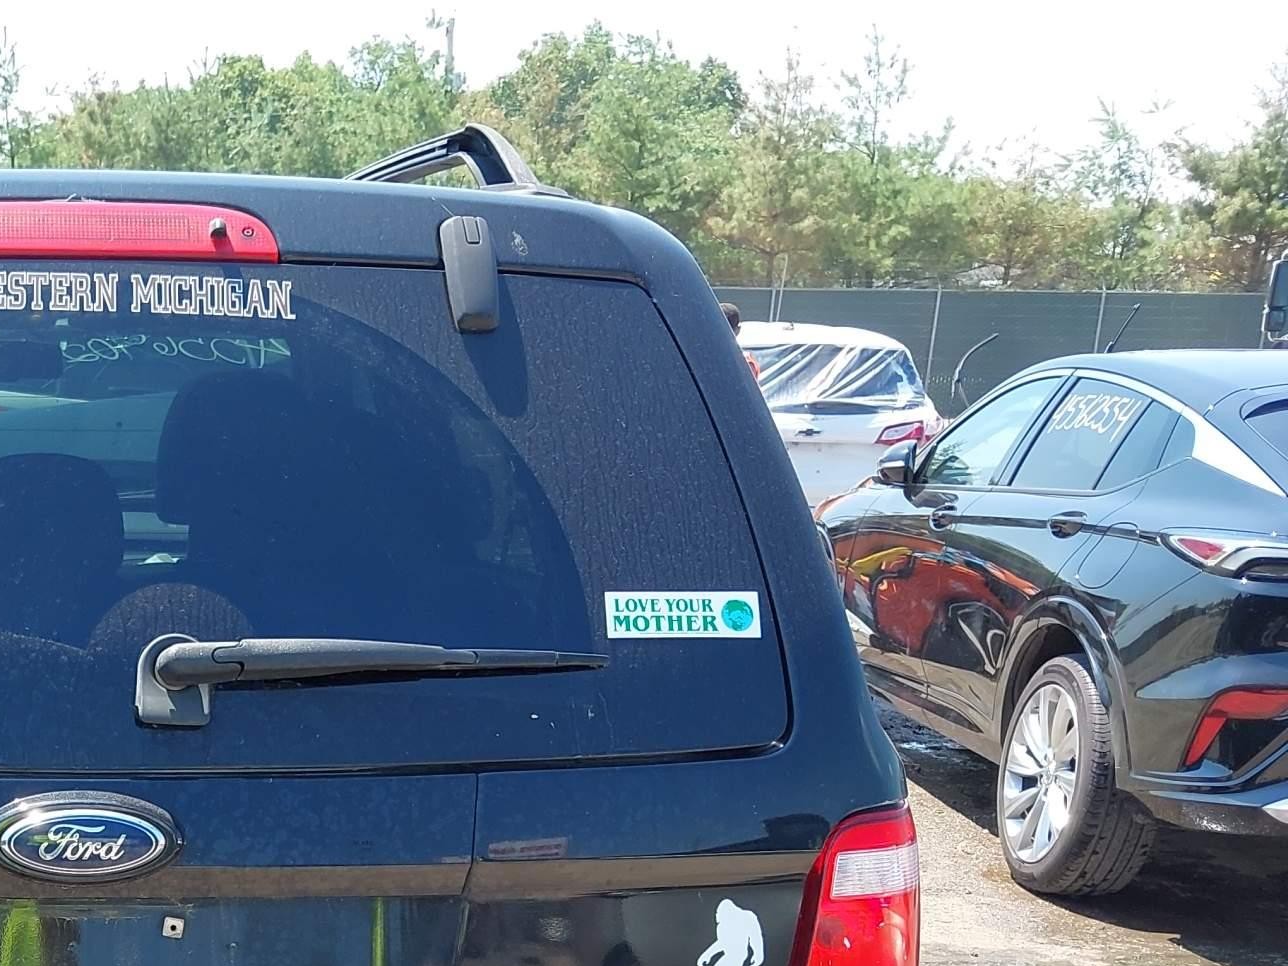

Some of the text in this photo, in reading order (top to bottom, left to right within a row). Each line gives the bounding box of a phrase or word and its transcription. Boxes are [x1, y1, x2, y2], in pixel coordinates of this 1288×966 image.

[130, 274, 296, 319] MICHIGAN
[614, 598, 714, 613] LOVE YOUR
[613, 615, 719, 632] MOTHER
[38, 824, 126, 861] Ford
